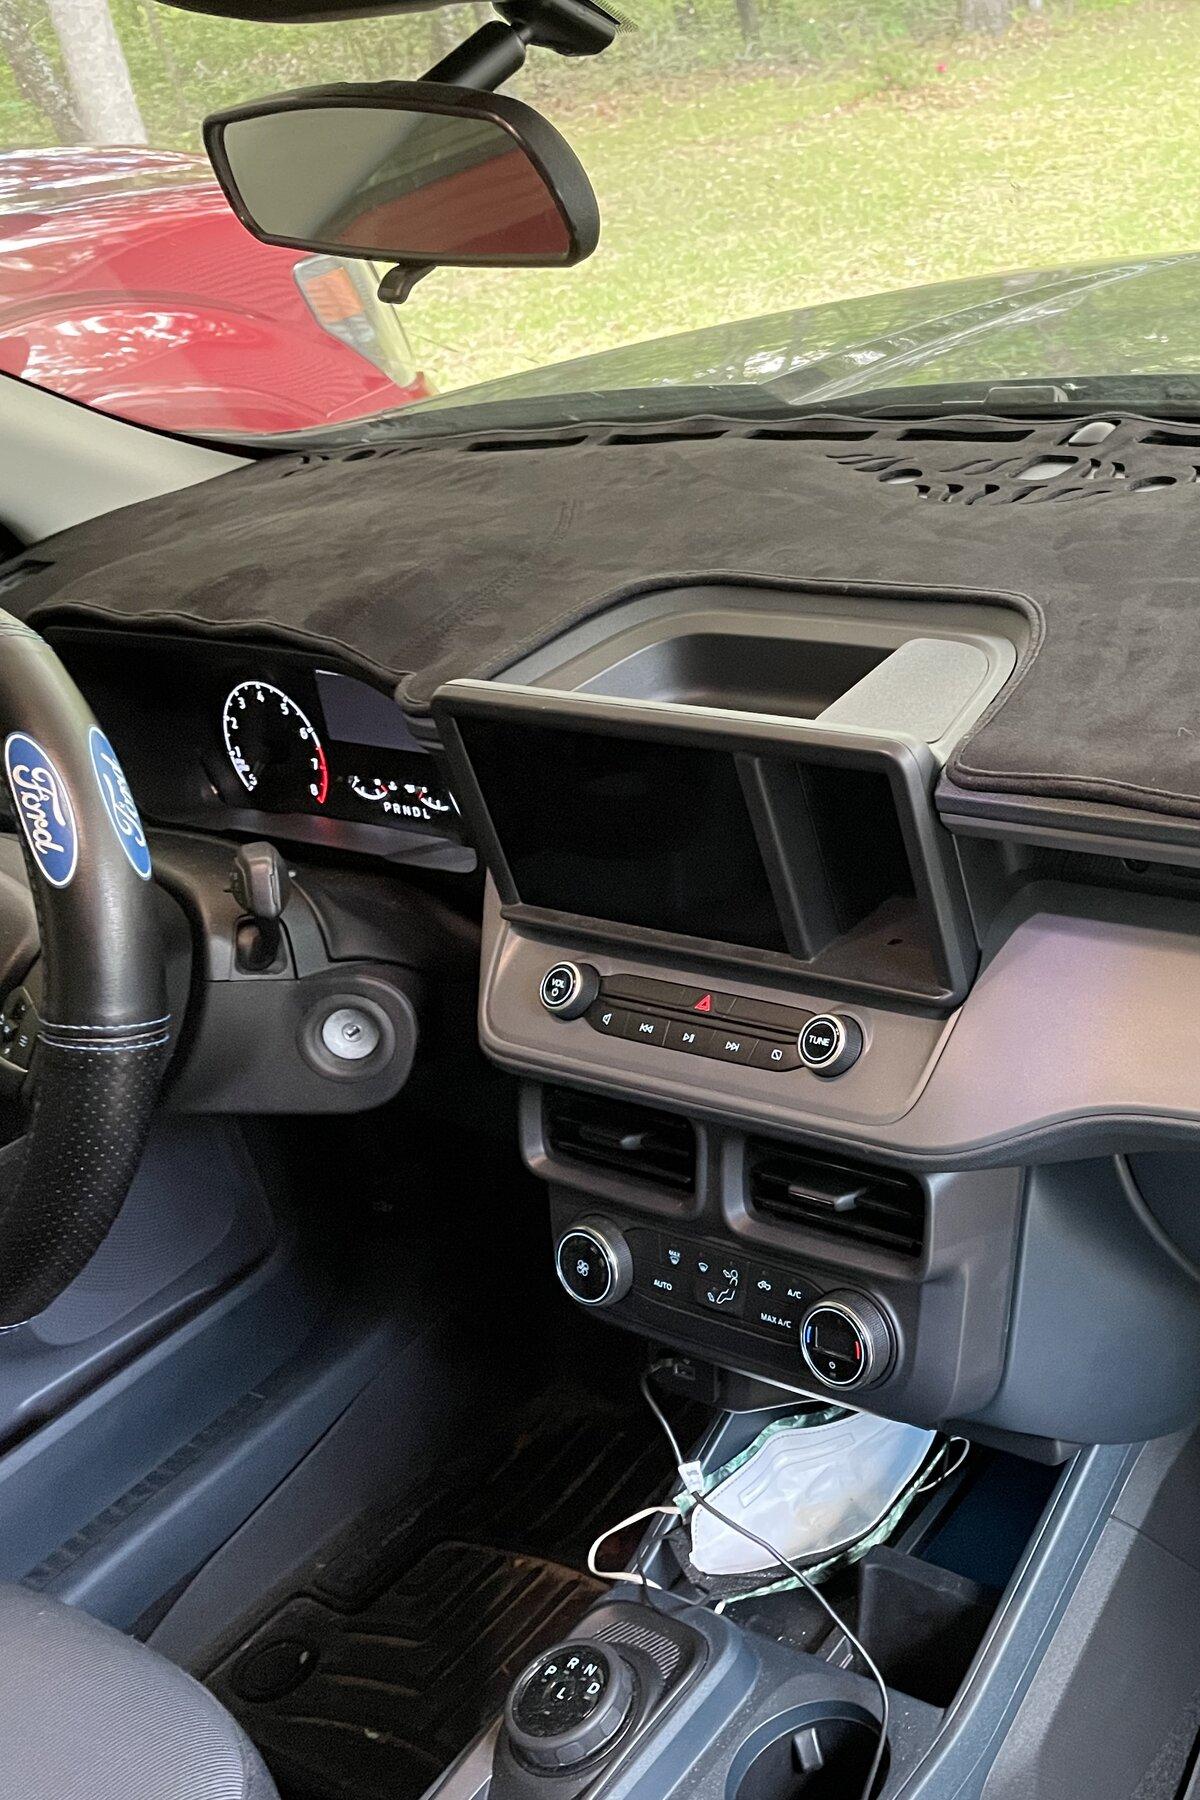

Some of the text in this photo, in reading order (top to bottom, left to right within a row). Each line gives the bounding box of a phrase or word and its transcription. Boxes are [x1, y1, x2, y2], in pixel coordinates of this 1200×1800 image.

[238, 697, 246, 709] 3
[280, 702, 289, 715] 5
[230, 716, 239, 730] 2
[300, 727, 308, 740] 6
[310, 757, 318, 771] 7
[310, 783, 319, 796] 8
[12, 764, 66, 855] Ford
[551, 978, 565, 989] VOL
[809, 1034, 830, 1047] TUNE
[668, 1249, 681, 1258] MAX
[653, 1279, 673, 1291] AUTO
[787, 1288, 802, 1299] A/C
[760, 1312, 792, 1329] MAX A/C
[544, 1664, 558, 1676] P
[566, 1657, 580, 1670] R
[583, 1663, 598, 1677] N
[556, 1687, 566, 1700] L
[586, 1682, 600, 1694] D
